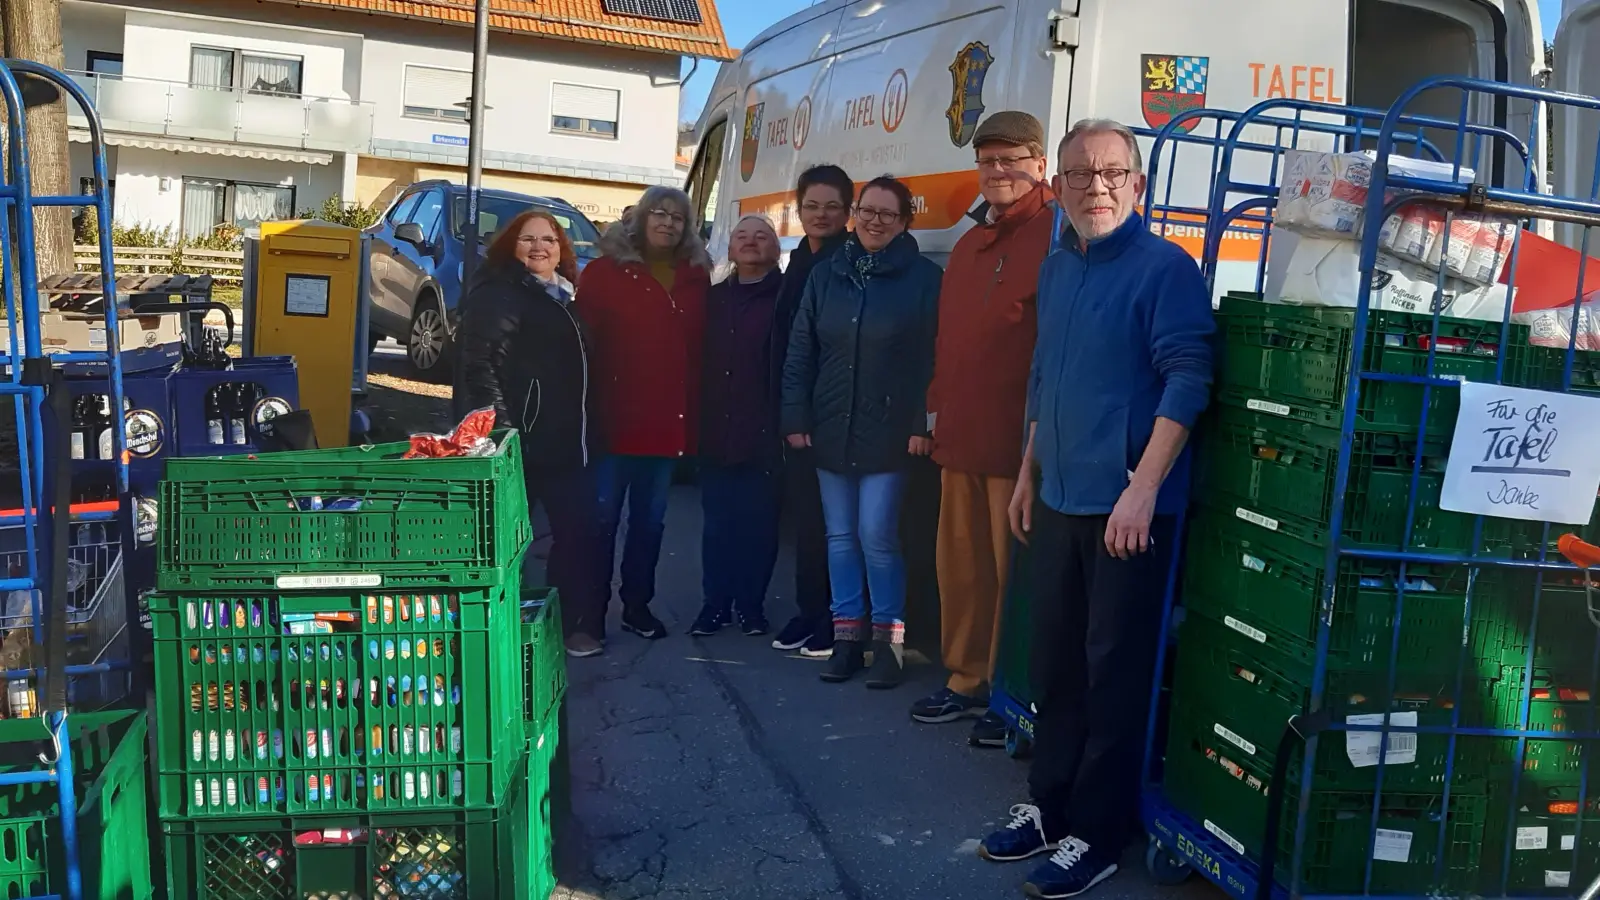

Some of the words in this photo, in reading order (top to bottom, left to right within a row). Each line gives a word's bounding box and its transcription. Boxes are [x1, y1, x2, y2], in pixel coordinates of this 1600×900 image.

[1248, 62, 1342, 104] TAFEL
[844, 95, 875, 131] TAFEL
[766, 117, 789, 148] TAFEL
[1391, 296, 1416, 311] ZUCKER
[1525, 403, 1557, 425] die
[1482, 424, 1558, 468] Tafel
[1486, 479, 1540, 510] Danke
[1176, 832, 1221, 880] EDEKA
